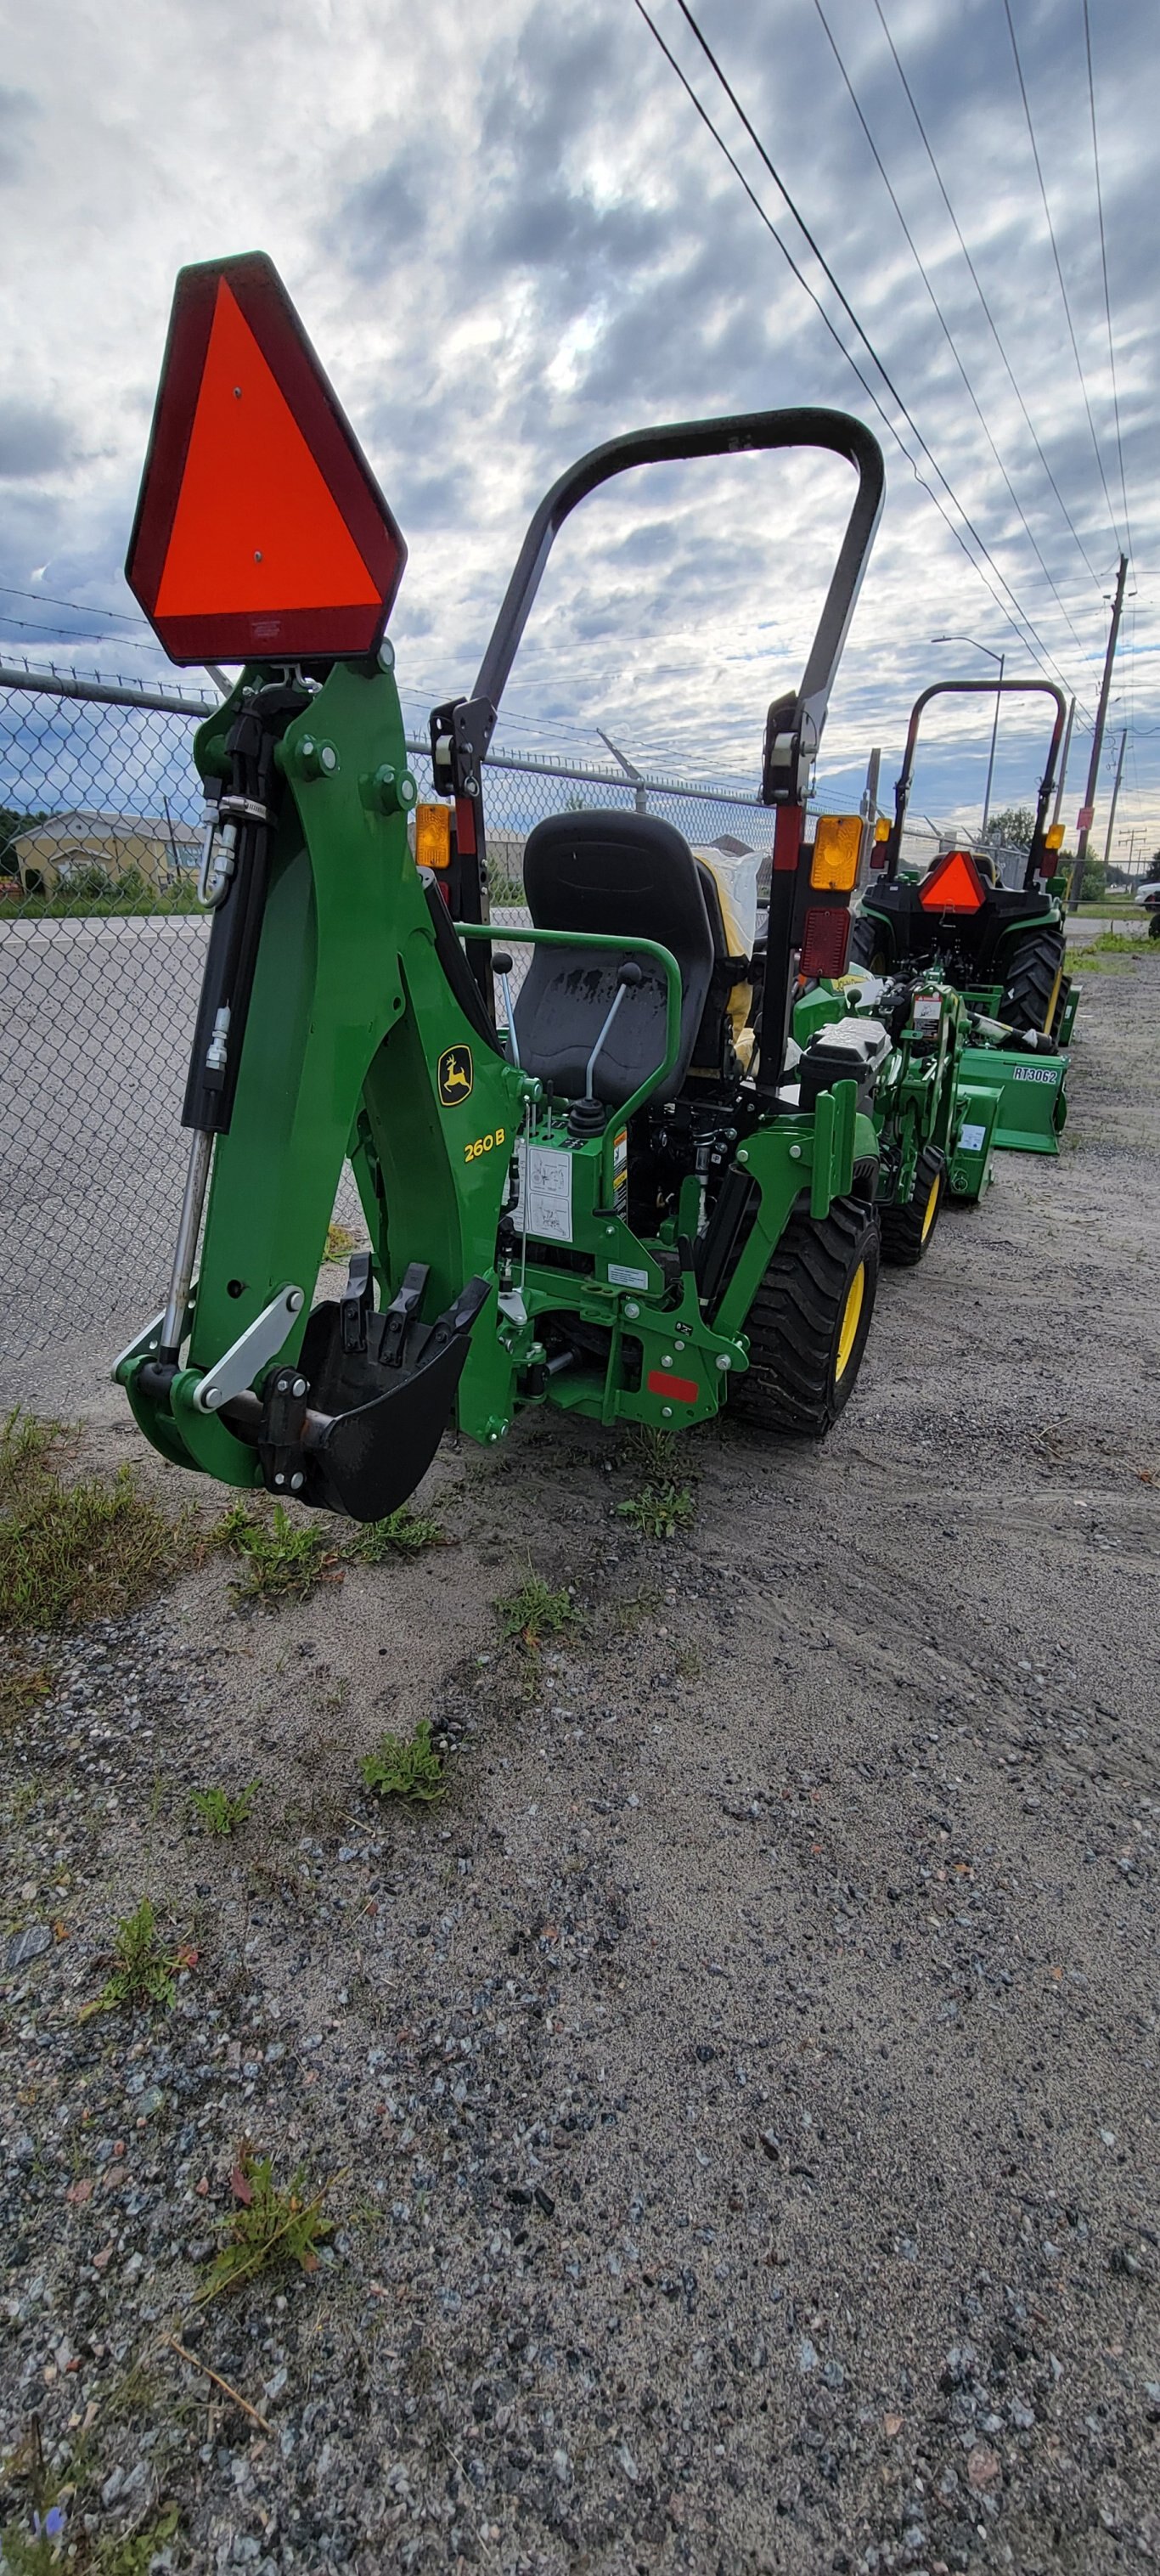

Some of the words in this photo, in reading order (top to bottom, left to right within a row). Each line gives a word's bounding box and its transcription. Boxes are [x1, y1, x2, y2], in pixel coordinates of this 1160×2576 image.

[1014, 1067, 1056, 1084] RT3062
[464, 1134, 493, 1163] 260
[495, 1128, 505, 1146] B
